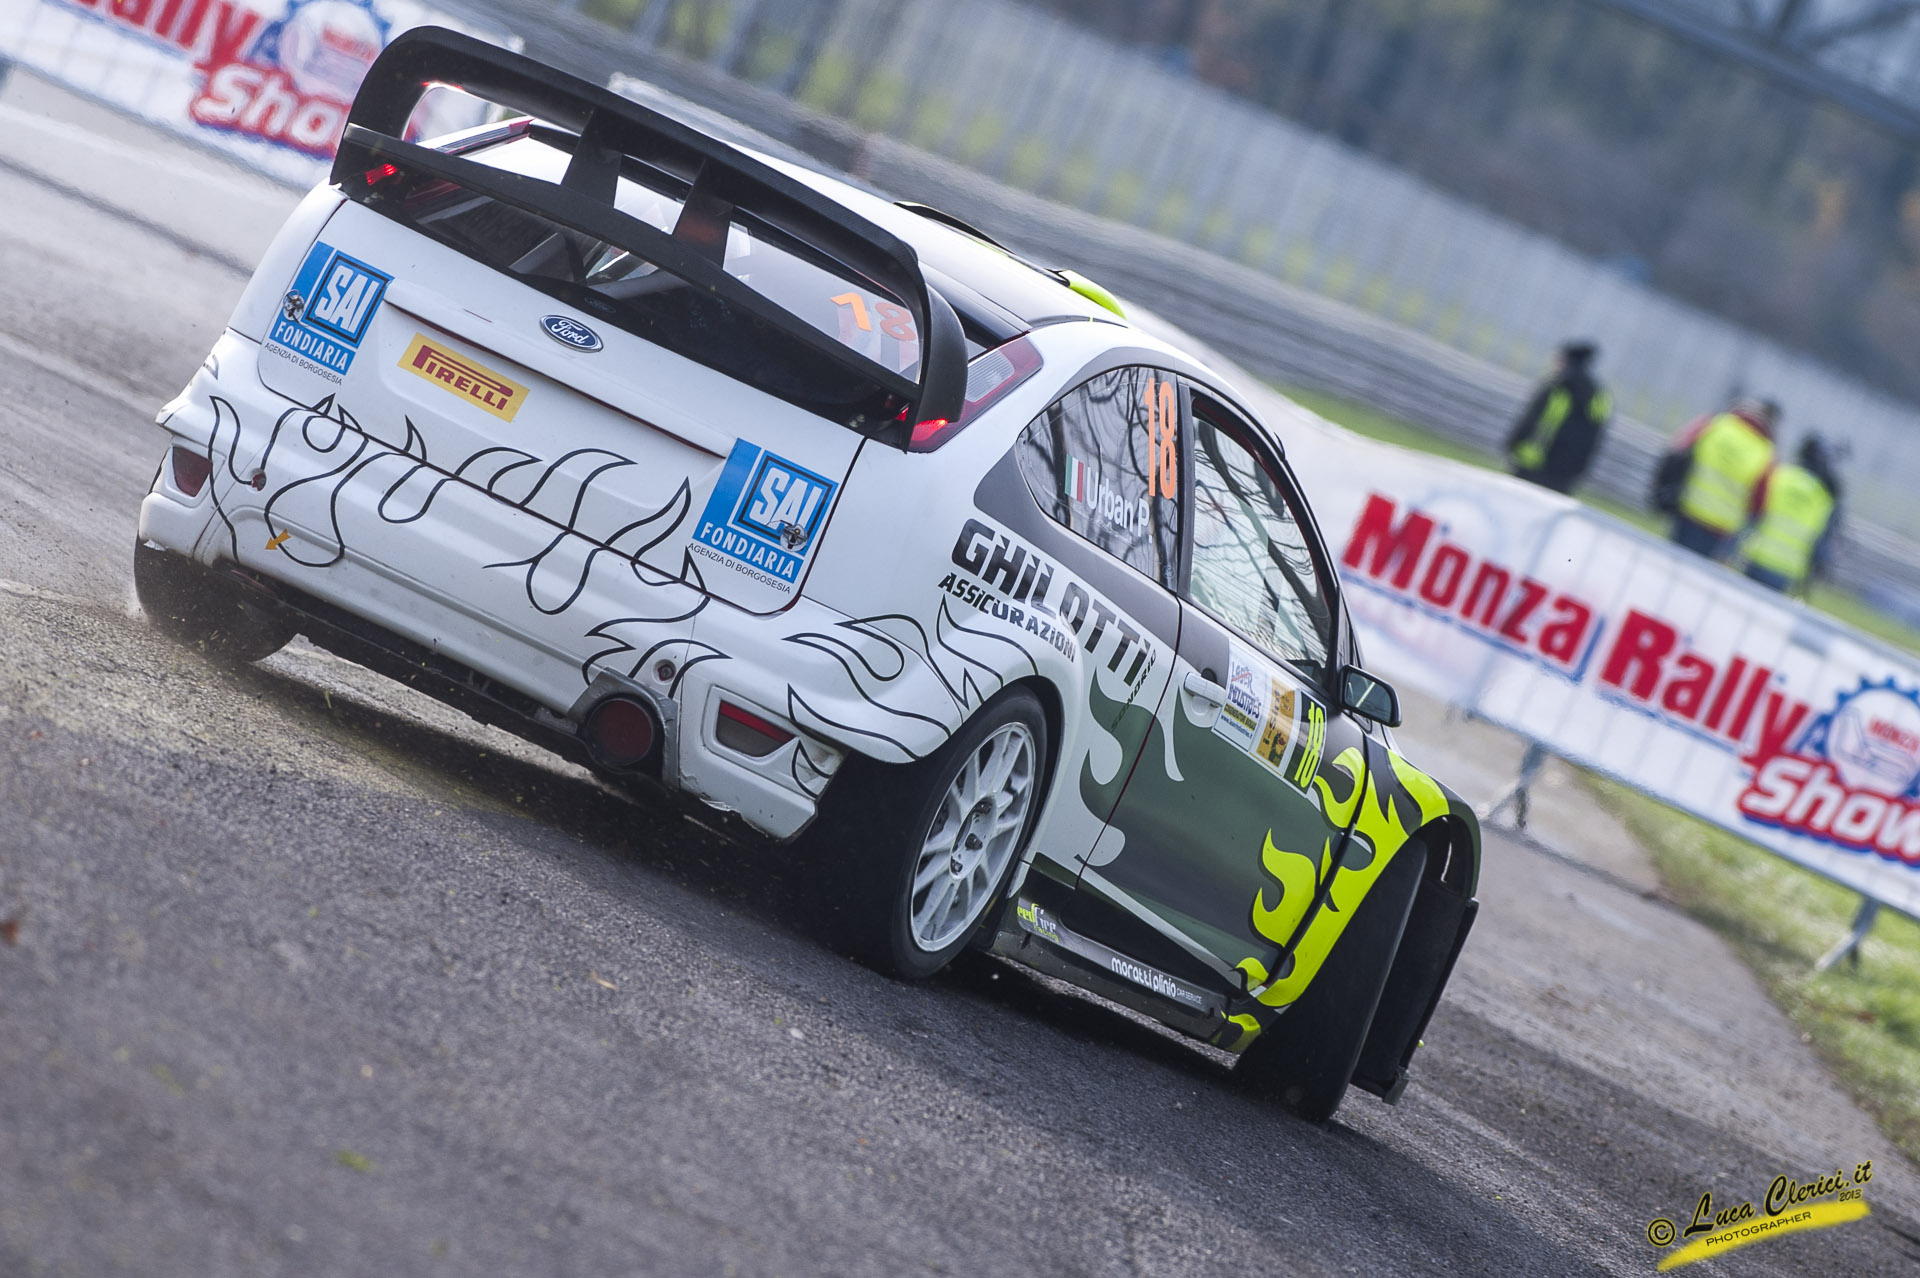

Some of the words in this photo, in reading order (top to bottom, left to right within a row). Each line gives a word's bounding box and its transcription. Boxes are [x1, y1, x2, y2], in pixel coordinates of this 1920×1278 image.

[188, 60, 346, 154] Sho
[314, 264, 381, 334] SAI
[551, 320, 589, 344] Ford
[830, 292, 917, 342] 18
[264, 342, 291, 363] AGENZIA
[290, 353, 299, 366] DI
[298, 356, 343, 386] BORGOSESIA
[273, 320, 349, 372] FONDIARIA
[412, 344, 514, 411] PIRELLI
[1144, 377, 1177, 499] 18
[748, 467, 823, 531] SAI
[1086, 466, 1134, 533] Urban
[687, 543, 724, 569] AGENZIA
[725, 559, 735, 570] DI
[735, 562, 791, 595] BORGOSESIA
[700, 521, 796, 579] FONDIARIA
[938, 572, 1077, 664] ASSICURAZIONI
[951, 518, 1152, 687] GHILOTTI
[1342, 492, 1593, 666] Monza
[1602, 608, 1810, 768] Rally
[1293, 701, 1325, 788] 18
[1738, 752, 1920, 862] Show
[1111, 957, 1152, 988] moratti
[1152, 972, 1177, 998] plinio
